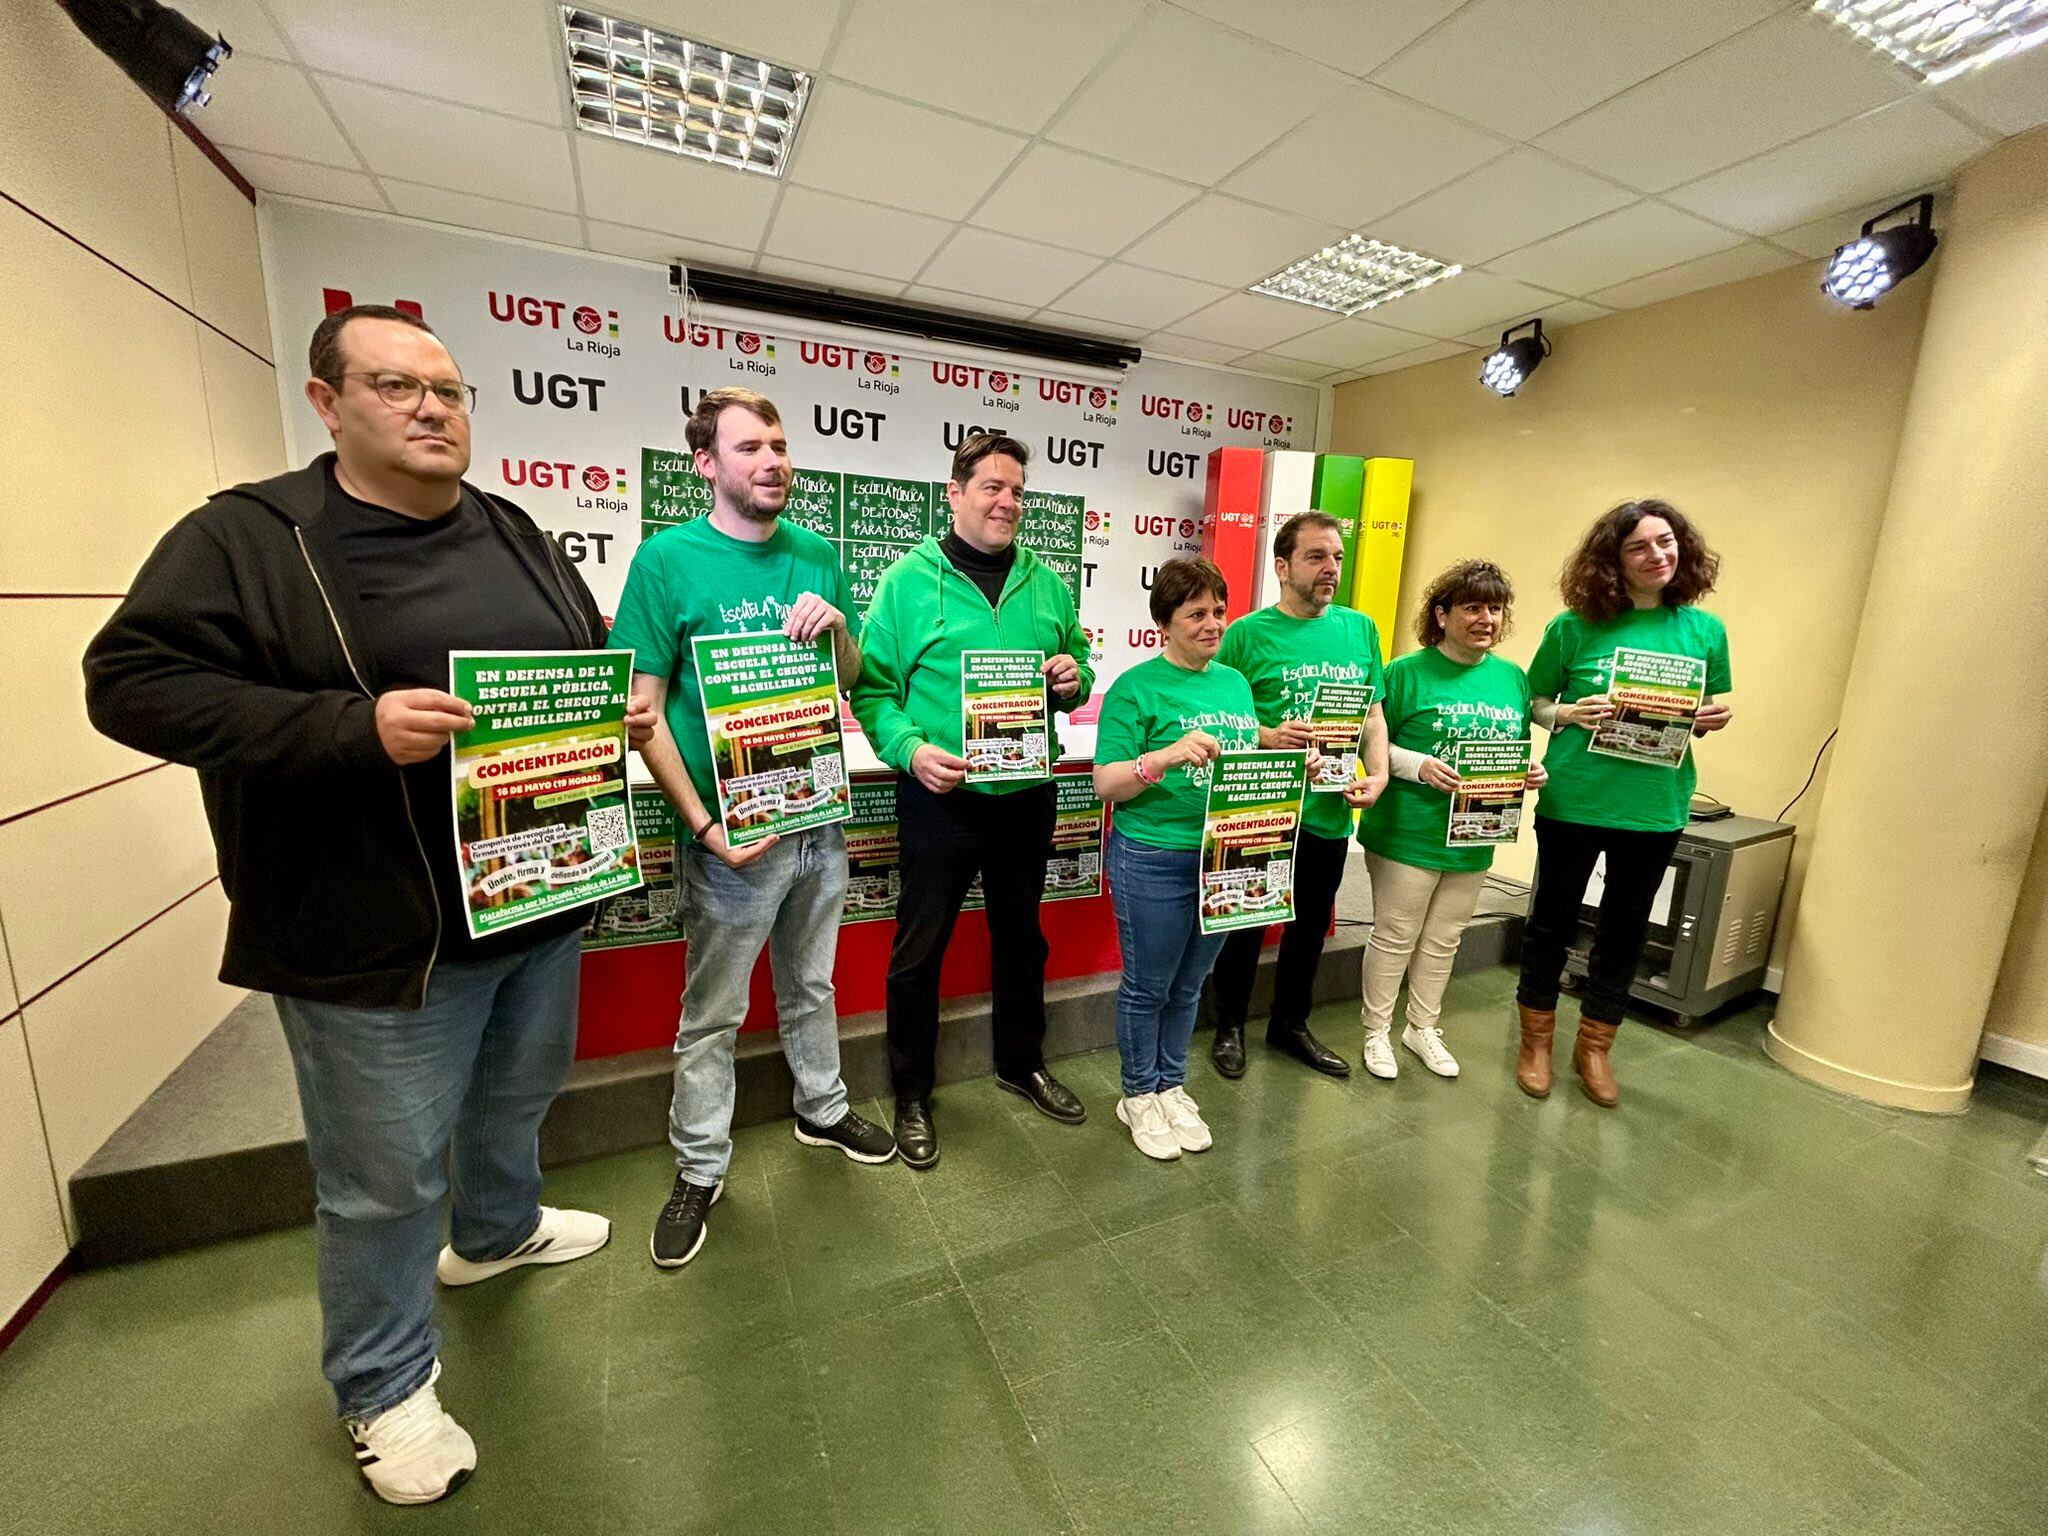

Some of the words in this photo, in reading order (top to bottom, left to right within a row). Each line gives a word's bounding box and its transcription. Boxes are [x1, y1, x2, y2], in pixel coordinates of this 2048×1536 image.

[488, 291, 565, 329] UGT
[663, 315, 731, 350] UGT
[567, 338, 583, 352] La
[587, 340, 621, 358] Rioja
[800, 340, 859, 371] UGT
[729, 357, 744, 371] La
[748, 360, 776, 376] Rioja
[933, 361, 985, 389] UGT
[512, 368, 606, 412] UGT
[858, 377, 872, 390] La
[874, 380, 900, 395] Rioja
[1039, 378, 1086, 406] UGT
[983, 396, 994, 407] La
[996, 398, 1020, 412] Rioja
[1141, 394, 1183, 420] UGT
[814, 404, 887, 442] UGT
[1083, 411, 1094, 423] La
[1096, 413, 1117, 427] Rioja
[1228, 408, 1266, 432] UGT
[1181, 425, 1191, 436] La
[1192, 427, 1211, 439] Rioja
[1047, 436, 1105, 468] UGT
[1263, 437, 1273, 447] La
[1274, 438, 1291, 450] Rioja
[1148, 449, 1199, 479] UGT
[501, 458, 576, 490] UGT
[663, 485, 678, 497] DE
[576, 496, 592, 509] La
[595, 498, 628, 513] Rioja
[862, 506, 877, 518] DE
[1025, 520, 1038, 530] DE
[1134, 515, 1176, 537] UGT
[1220, 512, 1241, 523] UGT
[1372, 521, 1391, 530] UGT
[853, 524, 883, 537] PARA
[549, 530, 614, 564] GT
[1090, 536, 1109, 547] Rioja
[1173, 541, 1183, 551] La
[860, 570, 876, 580] DE
[719, 601, 770, 623] ESCUELA
[710, 648, 729, 659] EN
[732, 643, 786, 657] DEFENSA
[805, 640, 817, 649] LA
[714, 658, 769, 671] ESCUELA
[475, 671, 500, 682] EN
[506, 668, 574, 681] DEFENSA
[578, 666, 595, 678] DE
[599, 665, 614, 677] LA
[704, 671, 756, 685] CONTRA
[759, 668, 774, 679] EL
[776, 664, 817, 676] CHEQUE
[819, 662, 832, 671] AL
[478, 685, 548, 700] ESCUELA
[552, 681, 612, 694] PÚBLICA,
[731, 677, 815, 695] BACHILLERATO
[472, 701, 527, 716] ONTRA
[533, 699, 550, 711] EL
[554, 694, 608, 709] CHEQUE
[611, 693, 626, 704] AL
[972, 700, 1040, 711] CONCENTRACIÓN
[1294, 691, 1312, 704] DE
[1618, 691, 1694, 706] CONCENTRACIÓN
[491, 709, 601, 730] BACHILLERATO
[725, 704, 830, 732] CONCENTRACIÓN
[752, 736, 762, 744] DE
[763, 733, 785, 743] MAYO
[1448, 727, 1465, 739] DE
[476, 743, 615, 779] CONCENTRACIÓN
[1223, 762, 1235, 771] EN
[1237, 761, 1273, 770] DEFENSA
[1286, 760, 1296, 768] LA
[1223, 772, 1258, 781] ESCUELA
[509, 784, 526, 795] DE
[526, 782, 552, 793] MAYO
[1213, 784, 1247, 792] CONTRA
[1261, 781, 1291, 789] CHEQUE
[1292, 780, 1302, 788] AL
[1462, 782, 1522, 791] CONCENTRACIÓN
[636, 800, 651, 808] DE
[653, 799, 665, 807] LA
[1227, 791, 1287, 802] BACHILLERATO
[1216, 816, 1292, 833] CONCENTRACIÓN
[511, 834, 521, 843] de
[554, 825, 565, 833] de
[544, 835, 556, 845] QR
[517, 867, 539, 878] firma
[540, 866, 546, 875] y
